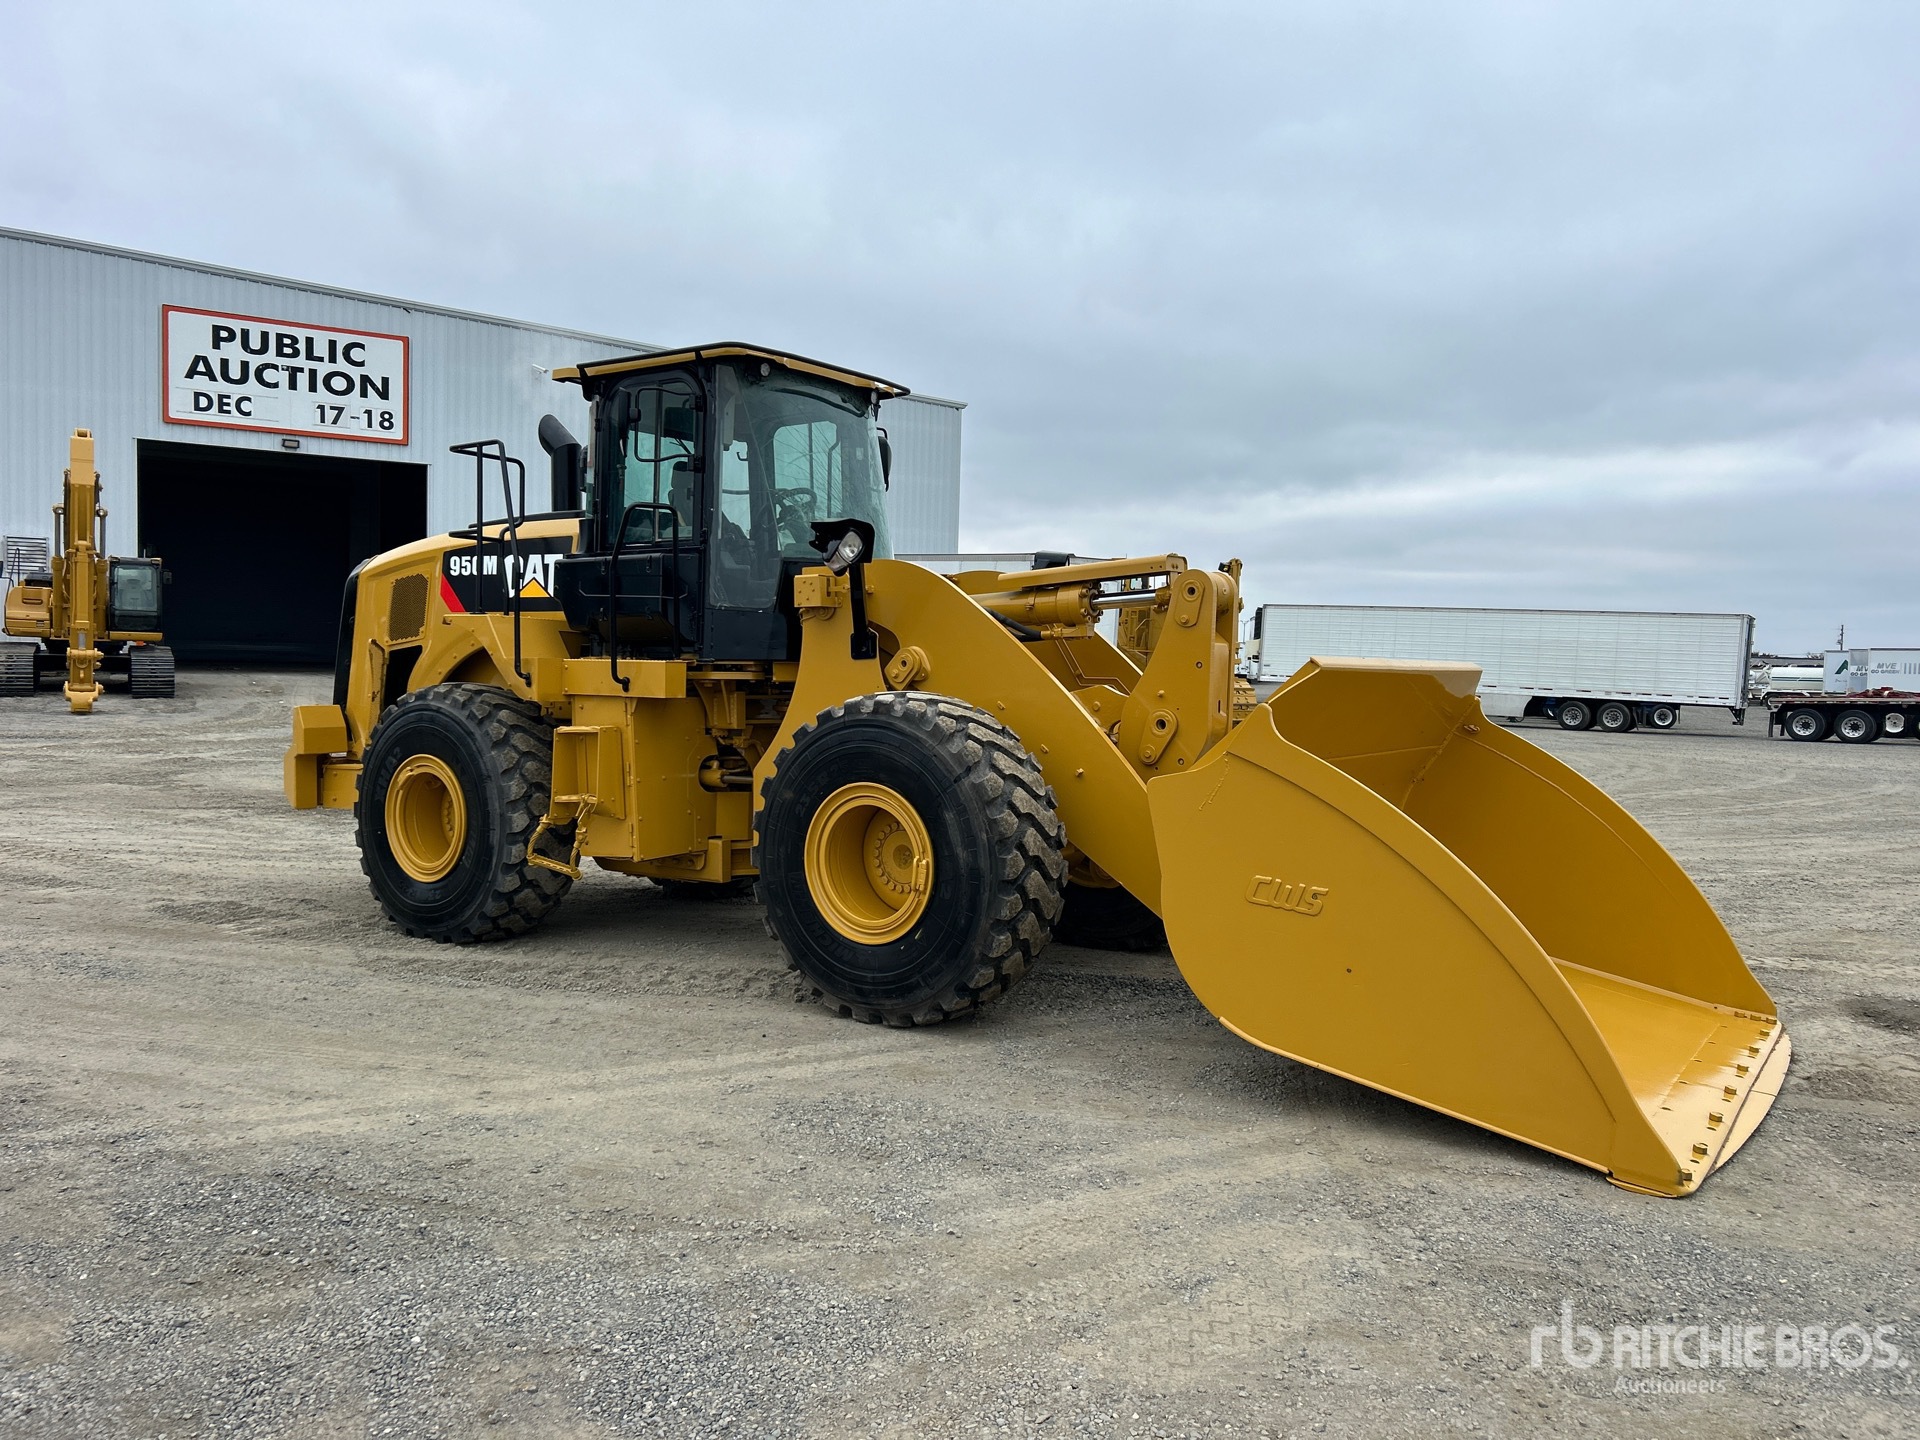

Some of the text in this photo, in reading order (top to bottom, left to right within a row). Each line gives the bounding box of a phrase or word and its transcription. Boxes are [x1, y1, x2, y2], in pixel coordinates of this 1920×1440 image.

[211, 324, 366, 367] PUBLIC
[184, 354, 390, 401] AUCTION
[193, 391, 395, 431] DEC 17-18
[504, 553, 564, 599] CAT
[1245, 875, 1330, 917] CWS
